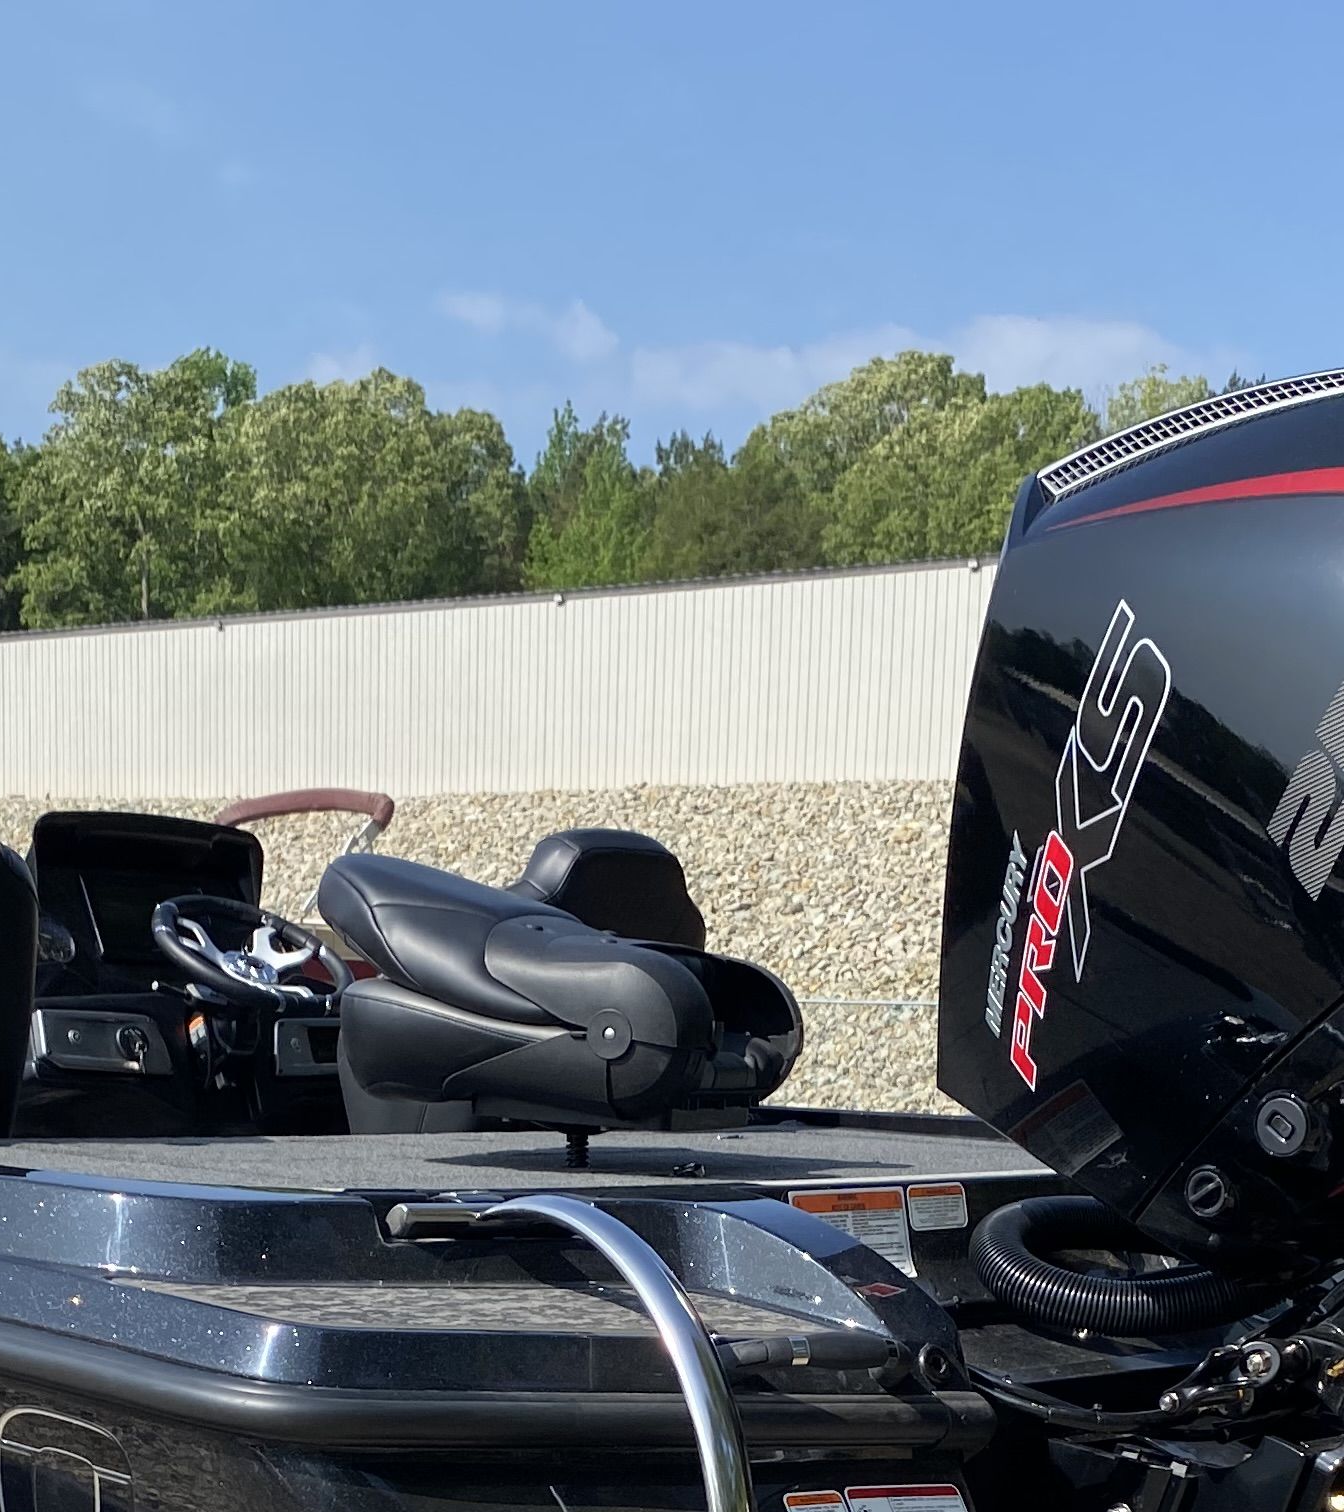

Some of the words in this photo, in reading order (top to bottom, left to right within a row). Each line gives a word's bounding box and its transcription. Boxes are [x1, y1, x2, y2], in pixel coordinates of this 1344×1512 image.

[1027, 598, 1172, 984] XS
[984, 829, 1028, 1040] MERCURY
[1009, 829, 1074, 1094] PRO
